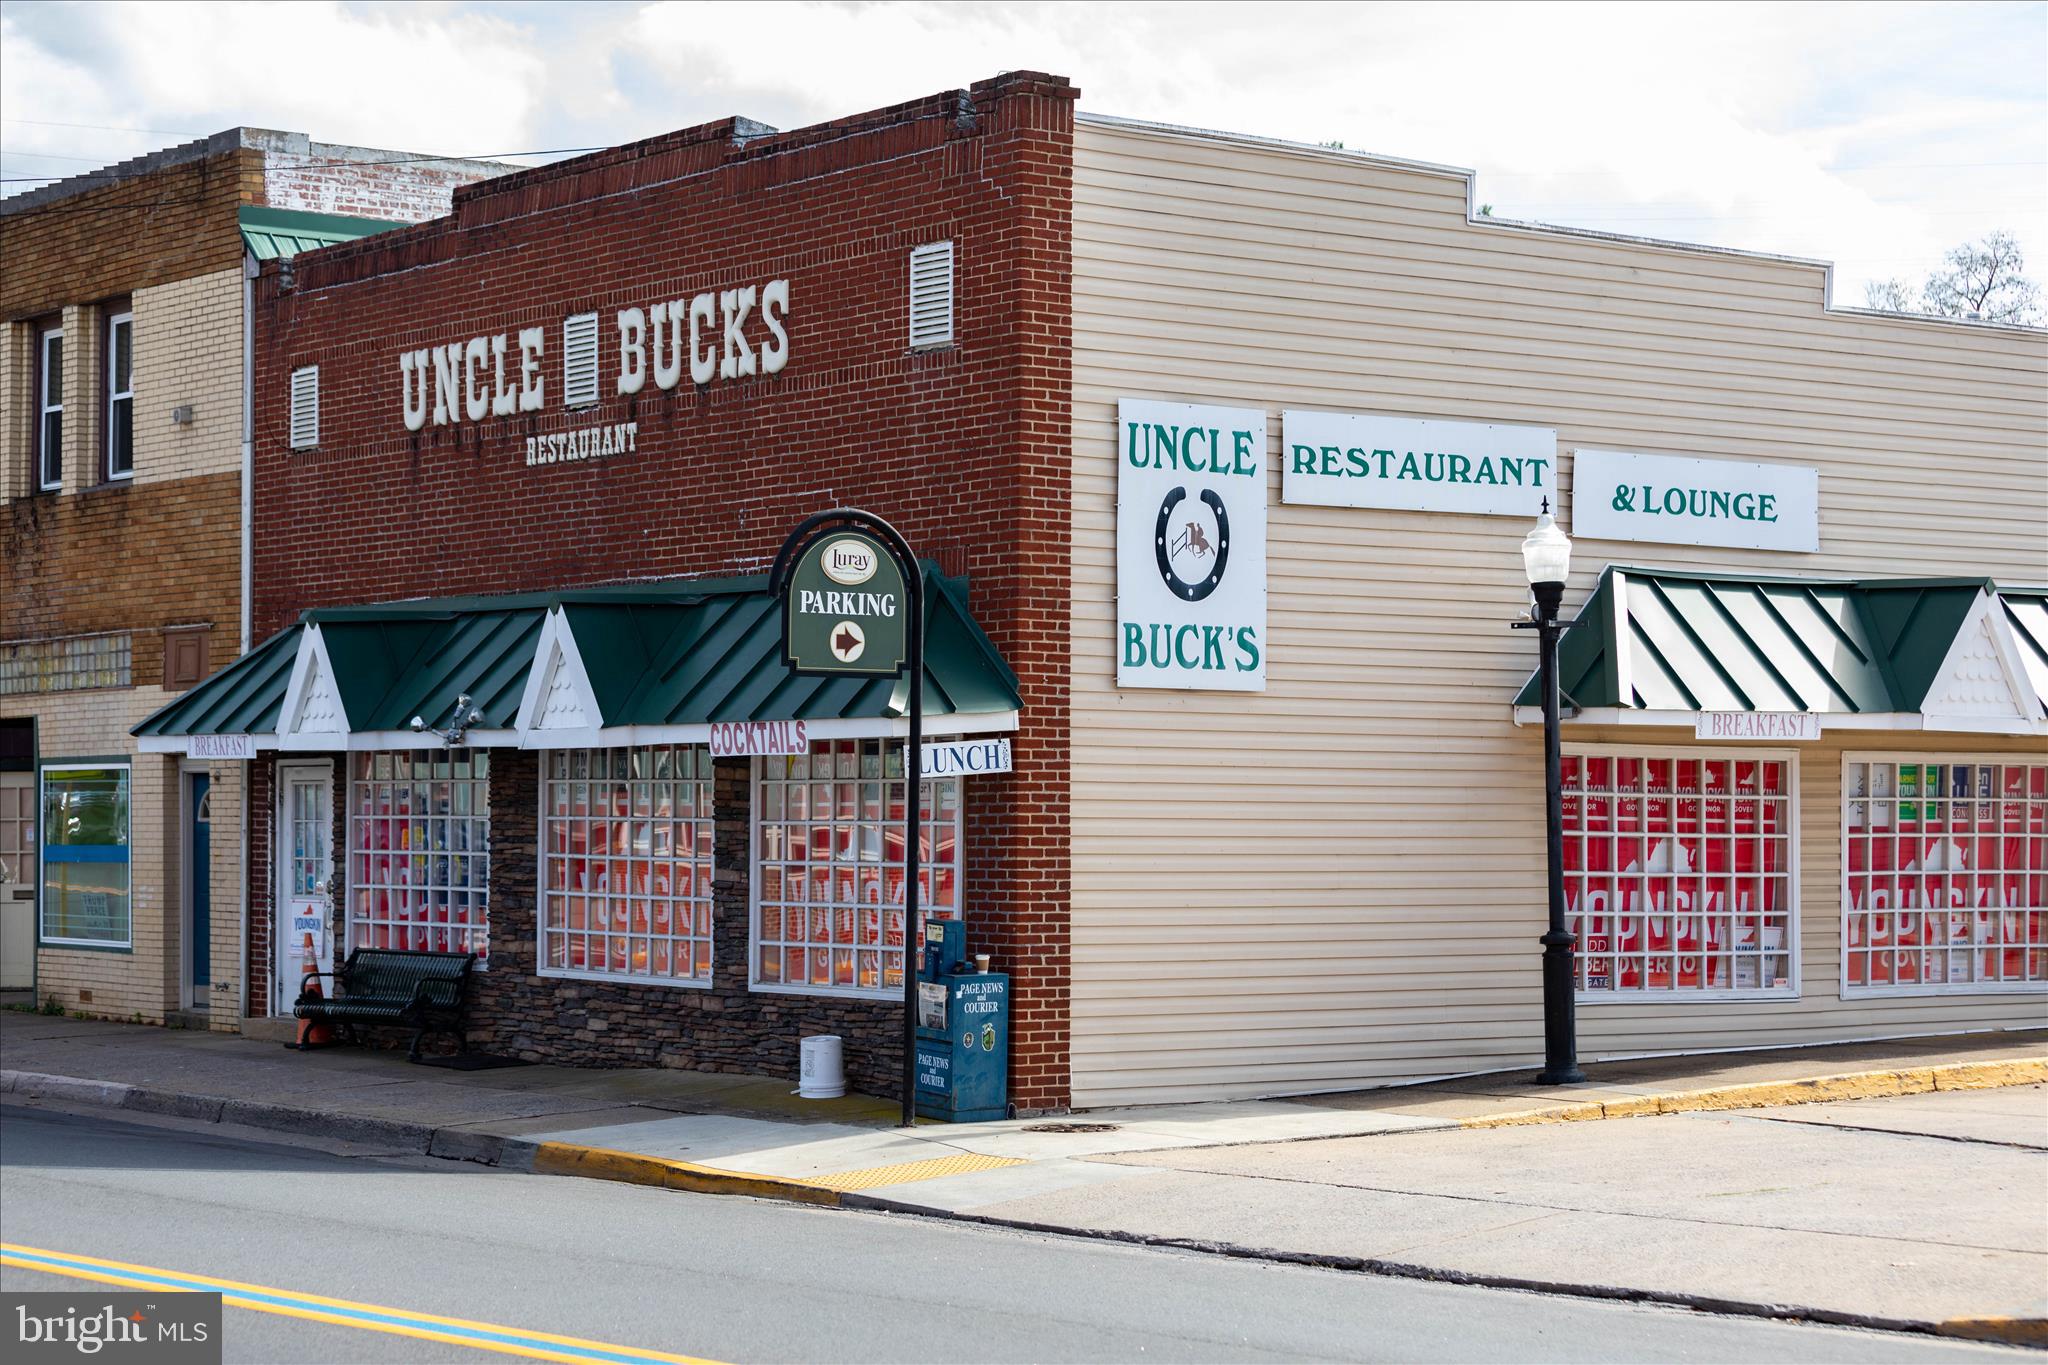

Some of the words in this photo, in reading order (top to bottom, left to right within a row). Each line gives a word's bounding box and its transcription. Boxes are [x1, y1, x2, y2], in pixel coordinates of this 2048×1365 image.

[400, 326, 545, 432] UNCLE
[617, 279, 790, 395] BUCKS
[526, 422, 638, 466] RESTAURANT
[1128, 422, 1257, 478] UNCLE
[1291, 444, 1549, 488] RESTAURANT
[1643, 485, 1779, 524] LOUNGE
[832, 549, 871, 571] Luray
[800, 590, 896, 617] PARKING
[1122, 622, 1260, 673] BUCK'S
[1712, 713, 1808, 737] BREAKFAST
[194, 735, 248, 756] BREAKFAST
[710, 720, 807, 755] COCKTAILS
[960, 983, 980, 995] PAGE
[981, 982, 1004, 994] NEWS
[976, 993, 987, 1002] and
[964, 1001, 999, 1013] COURIER
[918, 1053, 932, 1067] PAGE
[932, 1056, 949, 1070] NEWS
[929, 1067, 937, 1075] and
[920, 1073, 945, 1088] COURIER
